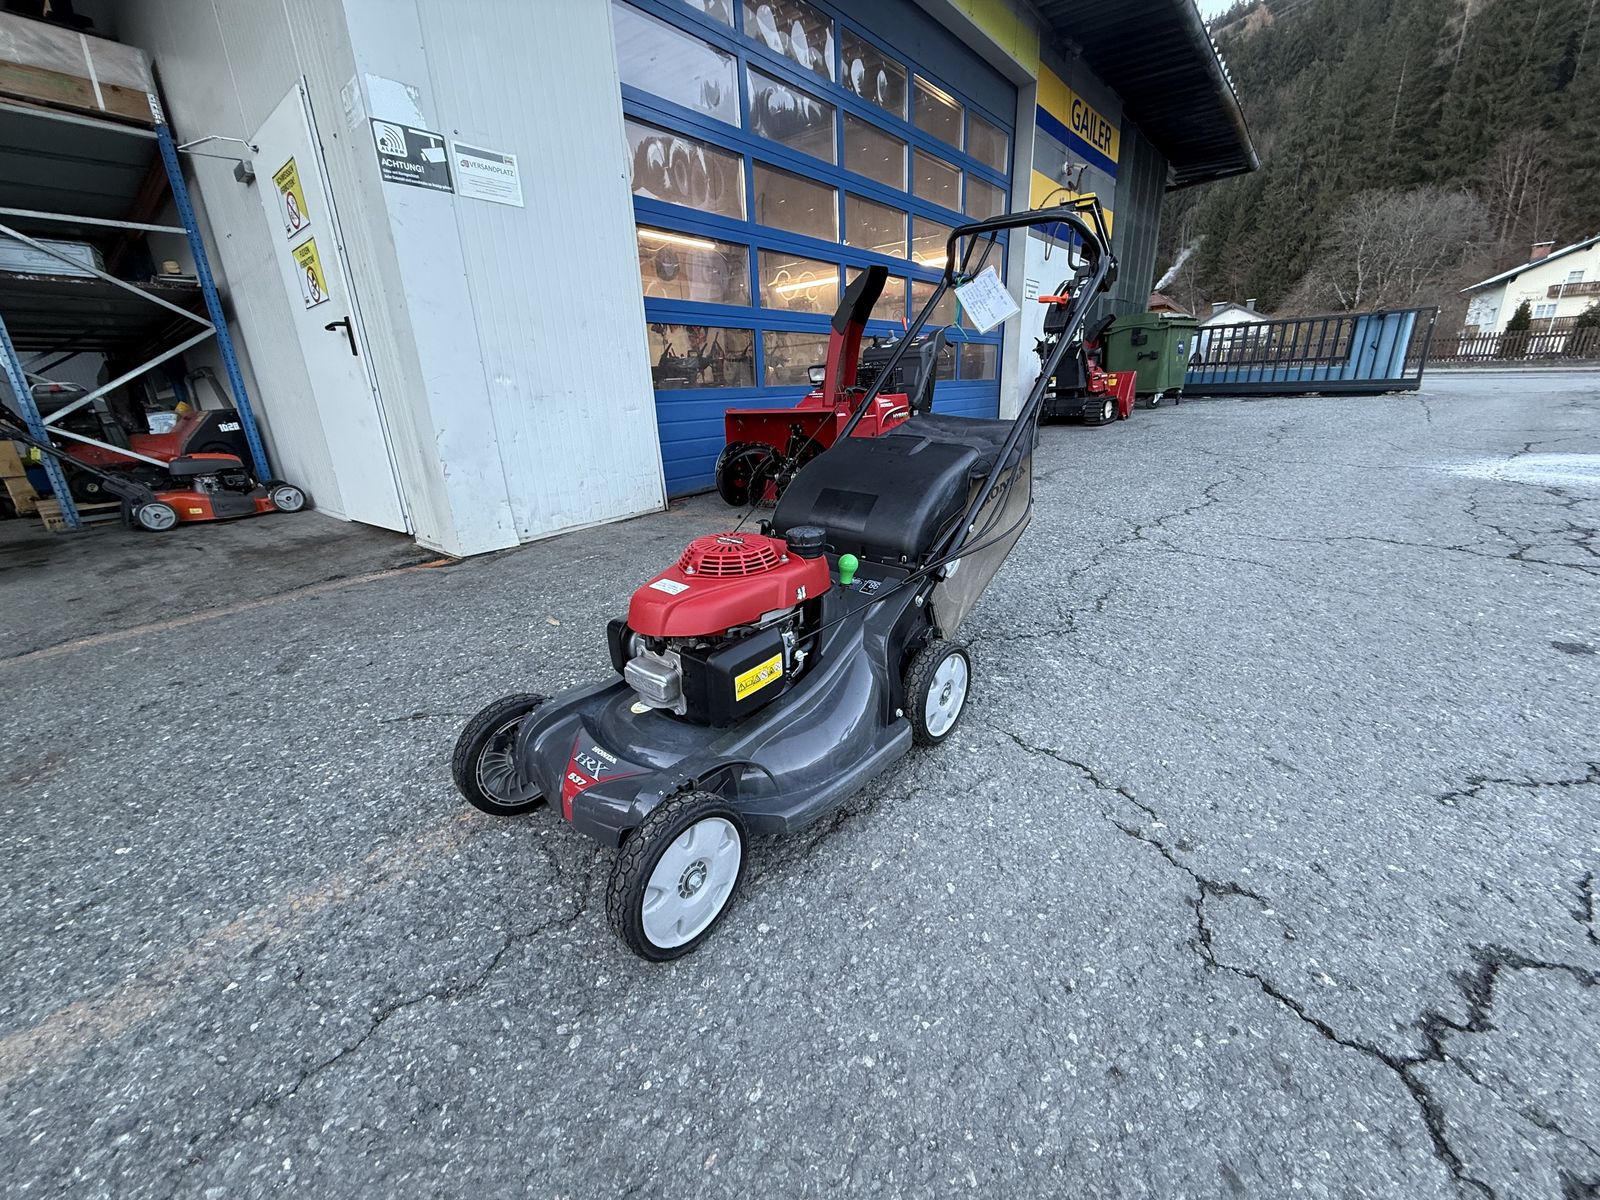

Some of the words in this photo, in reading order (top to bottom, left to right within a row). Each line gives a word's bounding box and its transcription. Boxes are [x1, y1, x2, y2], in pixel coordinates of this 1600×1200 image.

[1071, 98, 1111, 155] GAILER
[382, 158, 425, 174] ACHTUNG!
[469, 161, 514, 177] VERSANDPLATZ
[592, 746, 617, 764] HONDA
[573, 752, 610, 782] HRX
